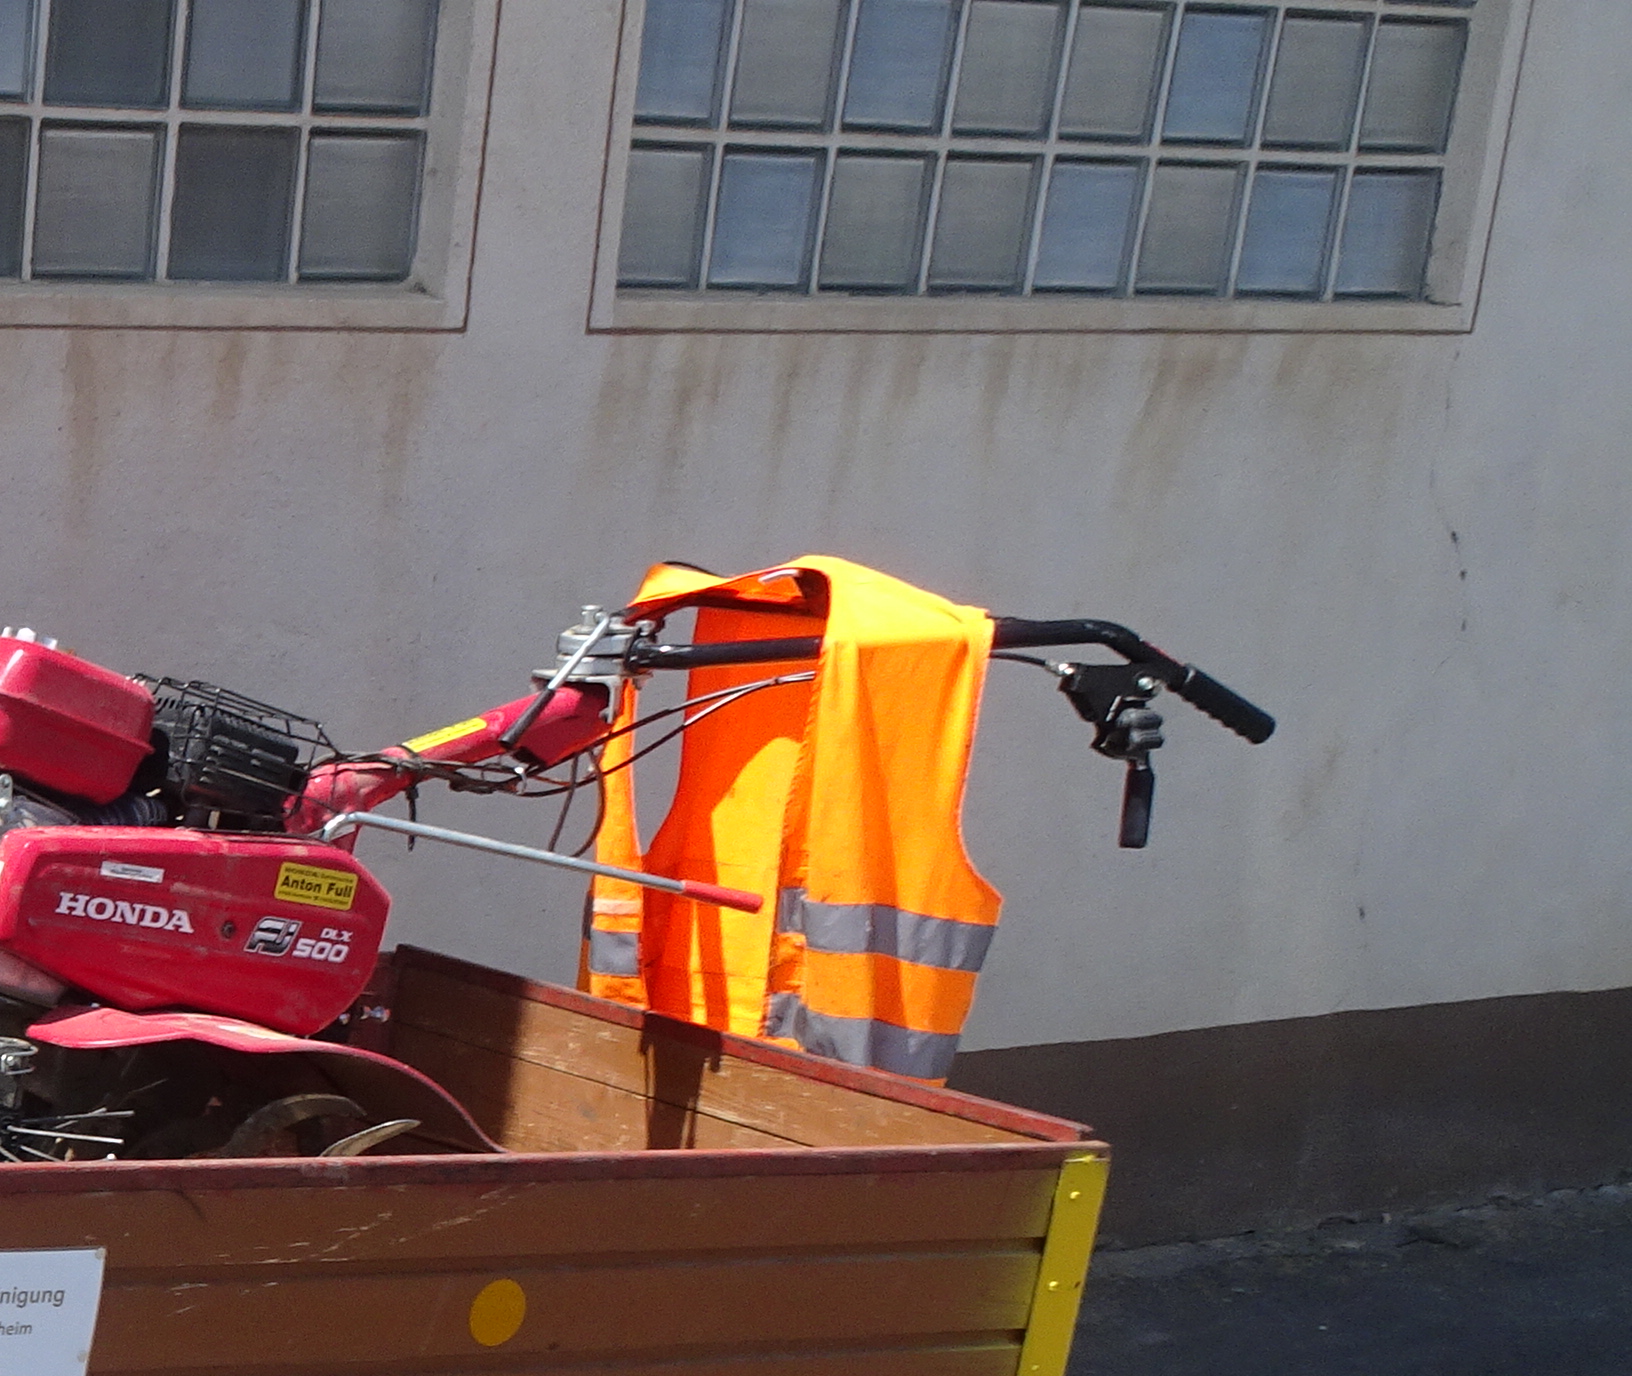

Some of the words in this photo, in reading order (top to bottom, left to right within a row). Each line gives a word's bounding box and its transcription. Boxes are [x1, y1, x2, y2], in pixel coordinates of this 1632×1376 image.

[280, 875, 322, 894] Anton
[326, 882, 354, 898] Full
[54, 891, 195, 934] HONDA
[320, 927, 354, 943] DLX
[292, 937, 350, 963] 500
